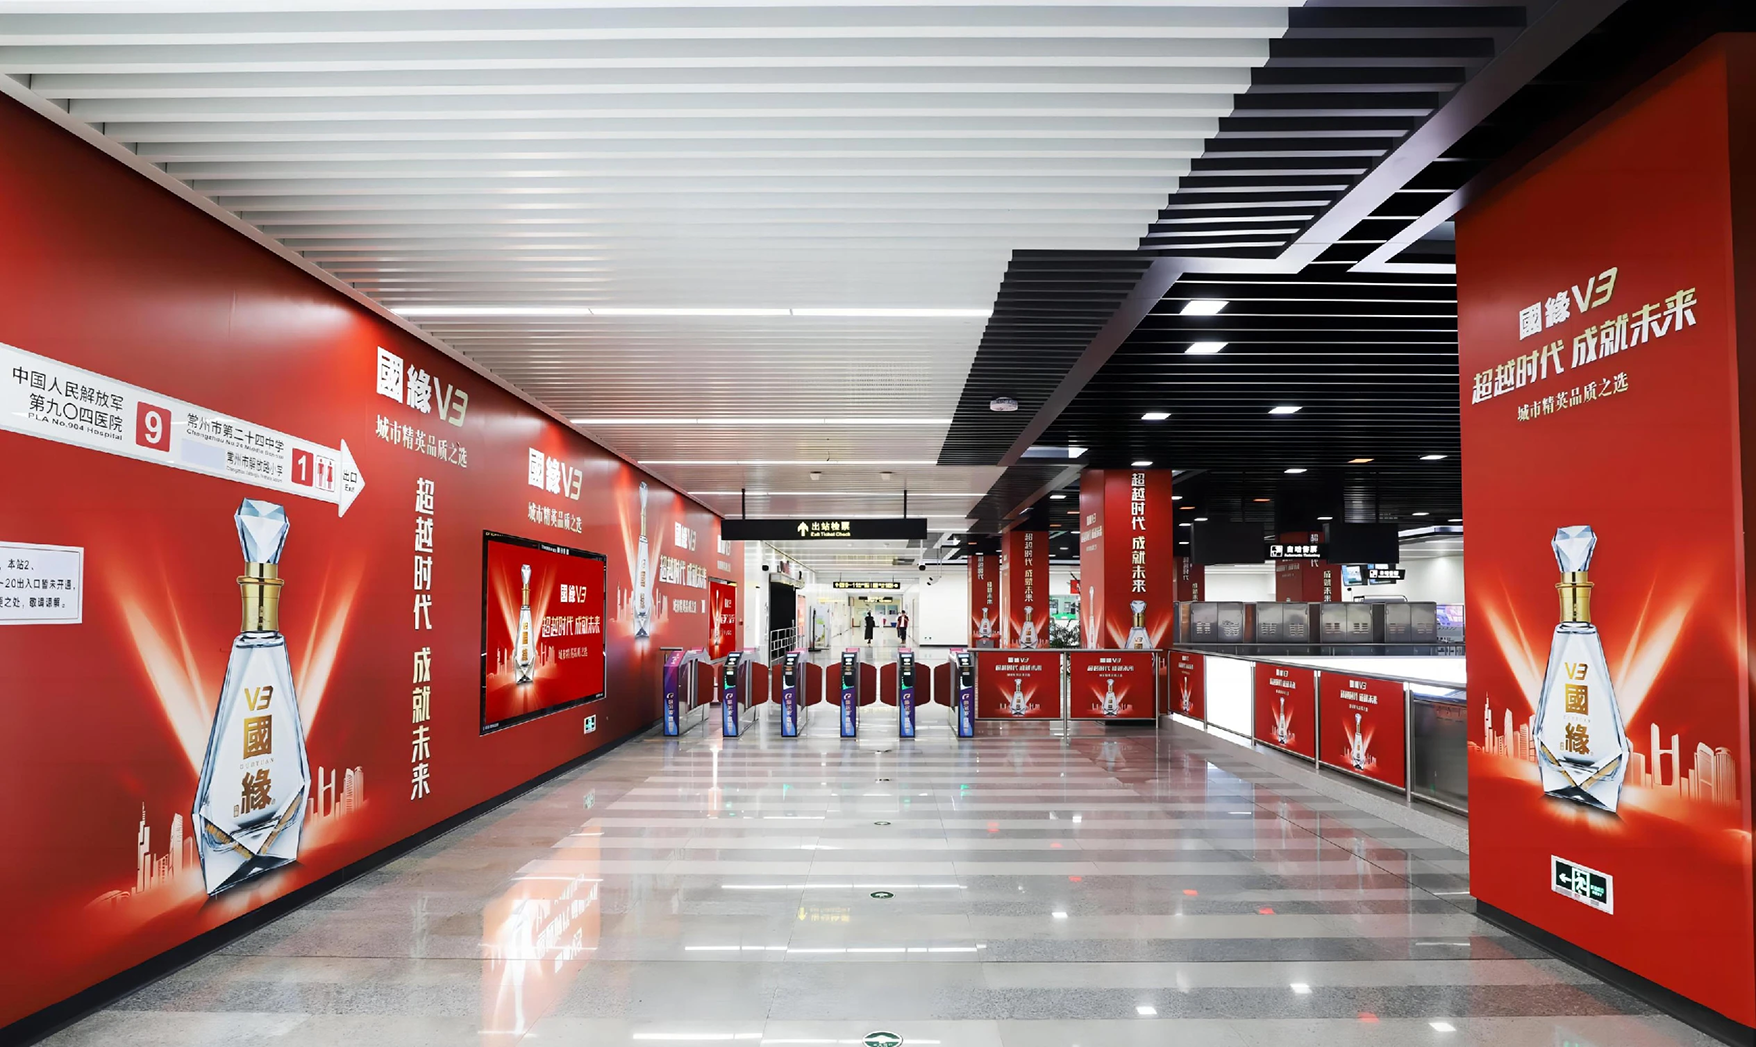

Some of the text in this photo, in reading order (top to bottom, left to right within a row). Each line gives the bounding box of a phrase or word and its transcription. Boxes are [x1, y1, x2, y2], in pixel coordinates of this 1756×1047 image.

[1519, 266, 1618, 341] 國緣V3
[1471, 287, 1698, 405] 超越时代 成就未来
[12, 366, 124, 411] 中国人民解放军
[376, 345, 469, 428] 國緣V3
[1517, 371, 1629, 422] 城市精英品质之选
[28, 412, 49, 423] PLA
[87, 426, 122, 441] Hospital
[144, 410, 164, 445] 9
[187, 412, 284, 453] 常州市第二十四中学
[375, 414, 467, 468] 城市精英品质之选
[297, 455, 306, 481] 1
[343, 469, 357, 484] 出口
[528, 446, 583, 501] 國緣V3
[527, 501, 582, 534] 城市精英品质之选
[811, 521, 850, 531] 出站检票
[1130, 473, 1147, 593] 超越时代 成就未来
[410, 477, 435, 801] 超越时代 成就未来
[542, 615, 574, 638] 超越时代
[1564, 661, 1588, 681] V3
[244, 685, 274, 711] V3
